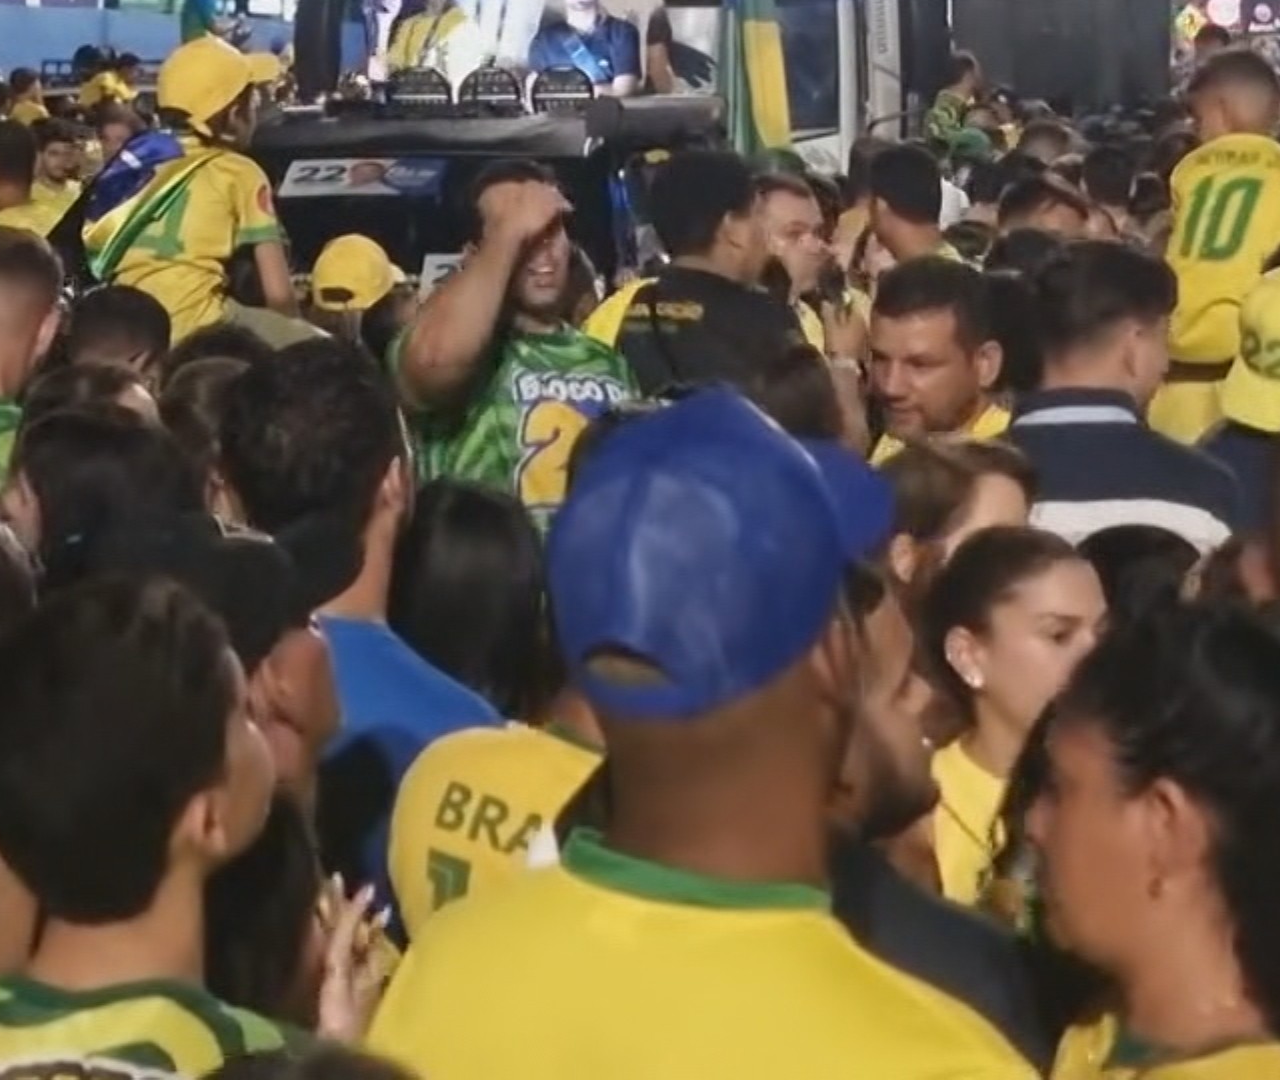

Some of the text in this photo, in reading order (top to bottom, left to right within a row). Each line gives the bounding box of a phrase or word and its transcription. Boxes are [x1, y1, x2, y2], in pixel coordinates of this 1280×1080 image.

[293, 165, 348, 184] 22
[1180, 175, 1264, 261] 10
[519, 399, 593, 508] 2
[435, 780, 542, 855] BRA
